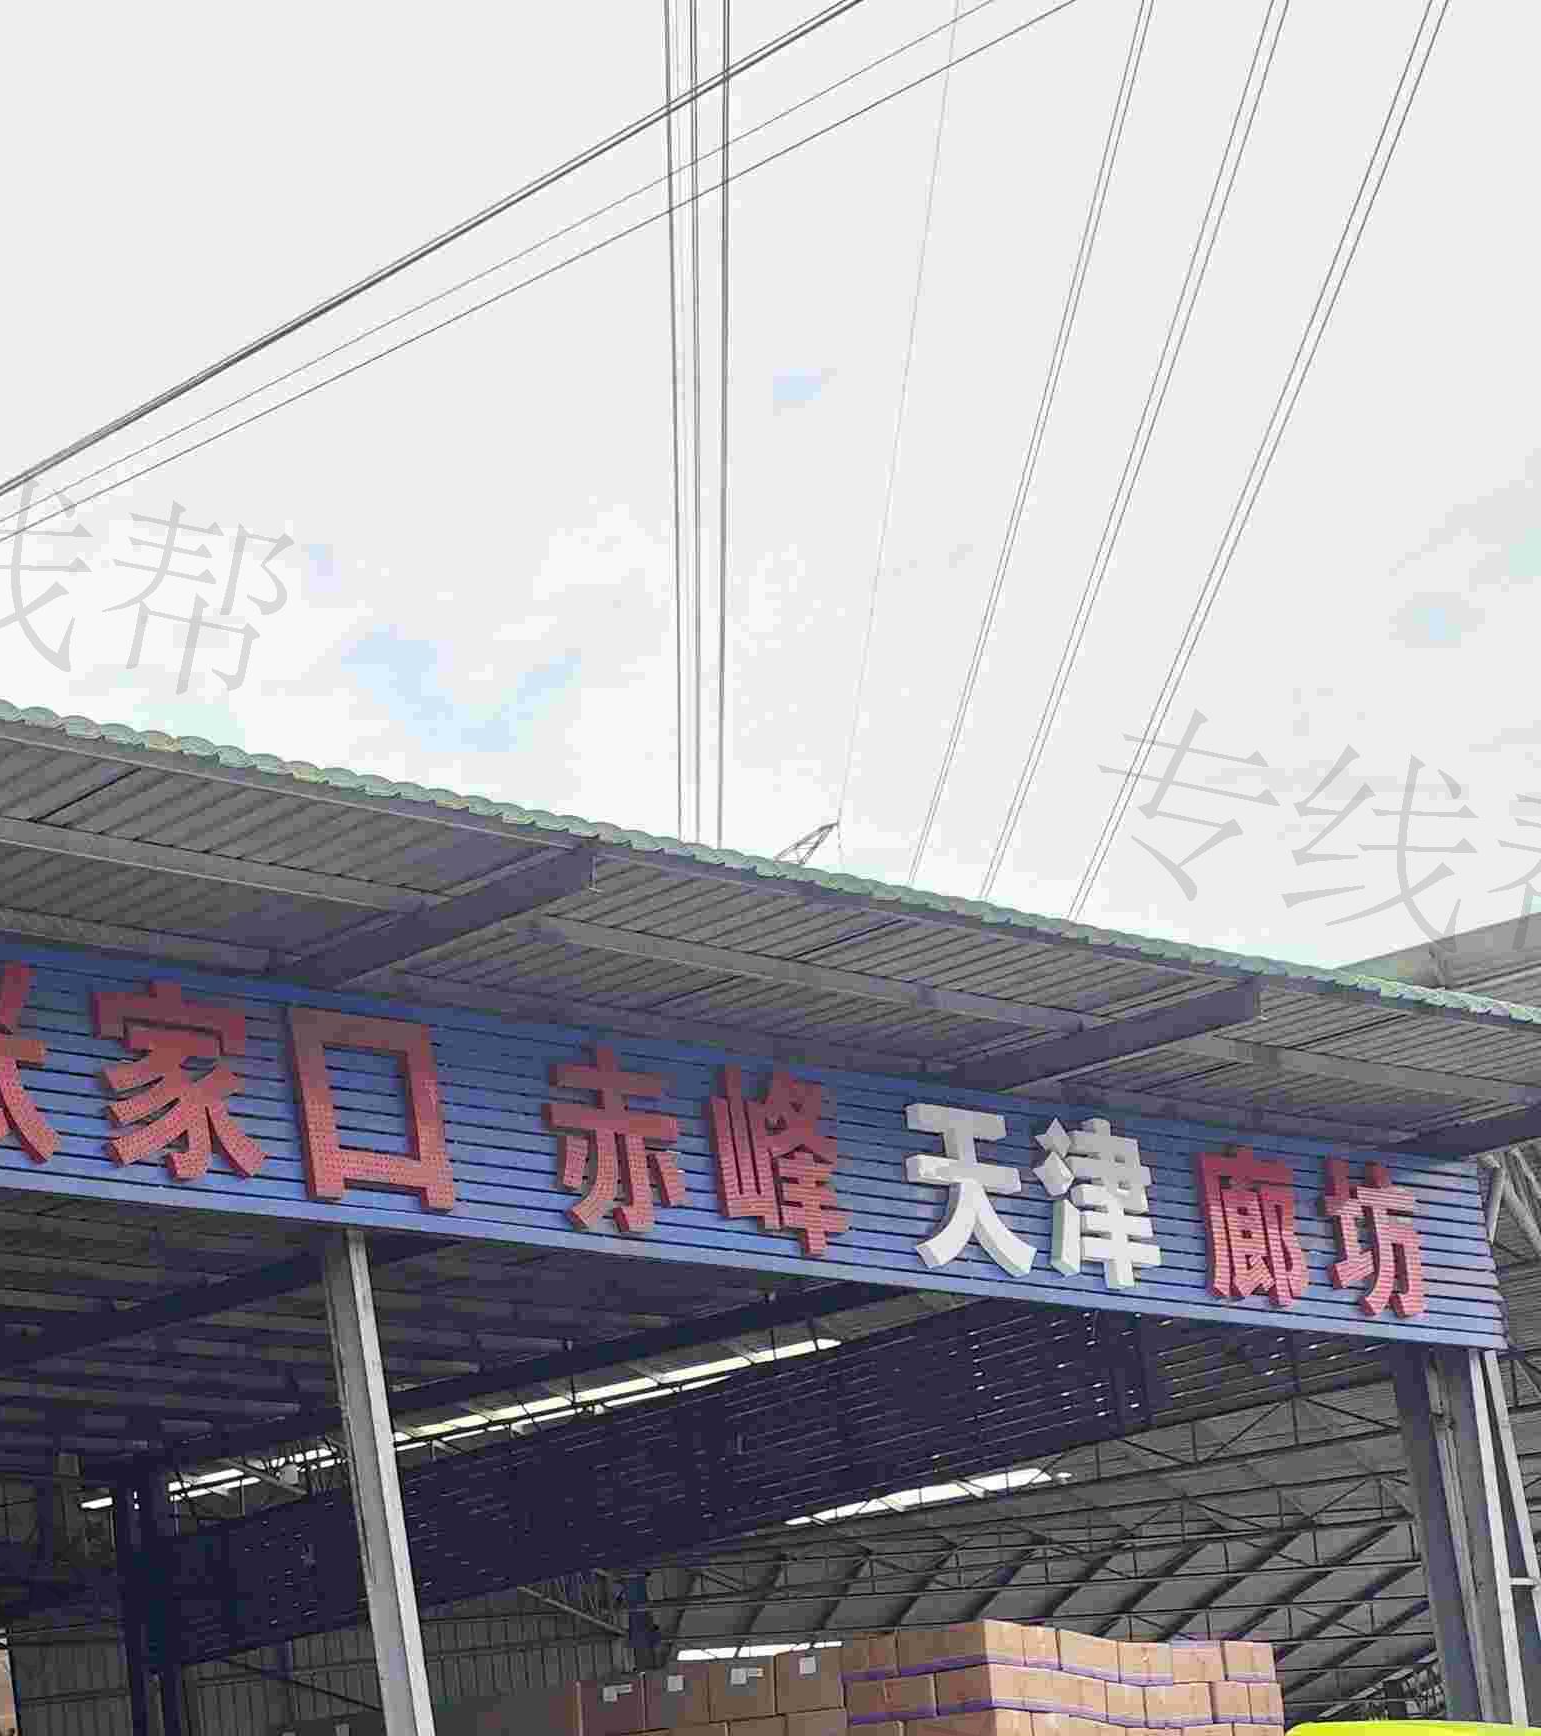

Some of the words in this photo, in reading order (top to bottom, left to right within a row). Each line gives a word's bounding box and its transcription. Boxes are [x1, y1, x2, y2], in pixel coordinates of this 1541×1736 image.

[541, 1046, 848, 1256] 赤峰
[904, 1102, 1161, 1290] 天津
[1193, 1144, 1425, 1317] 廊坊
